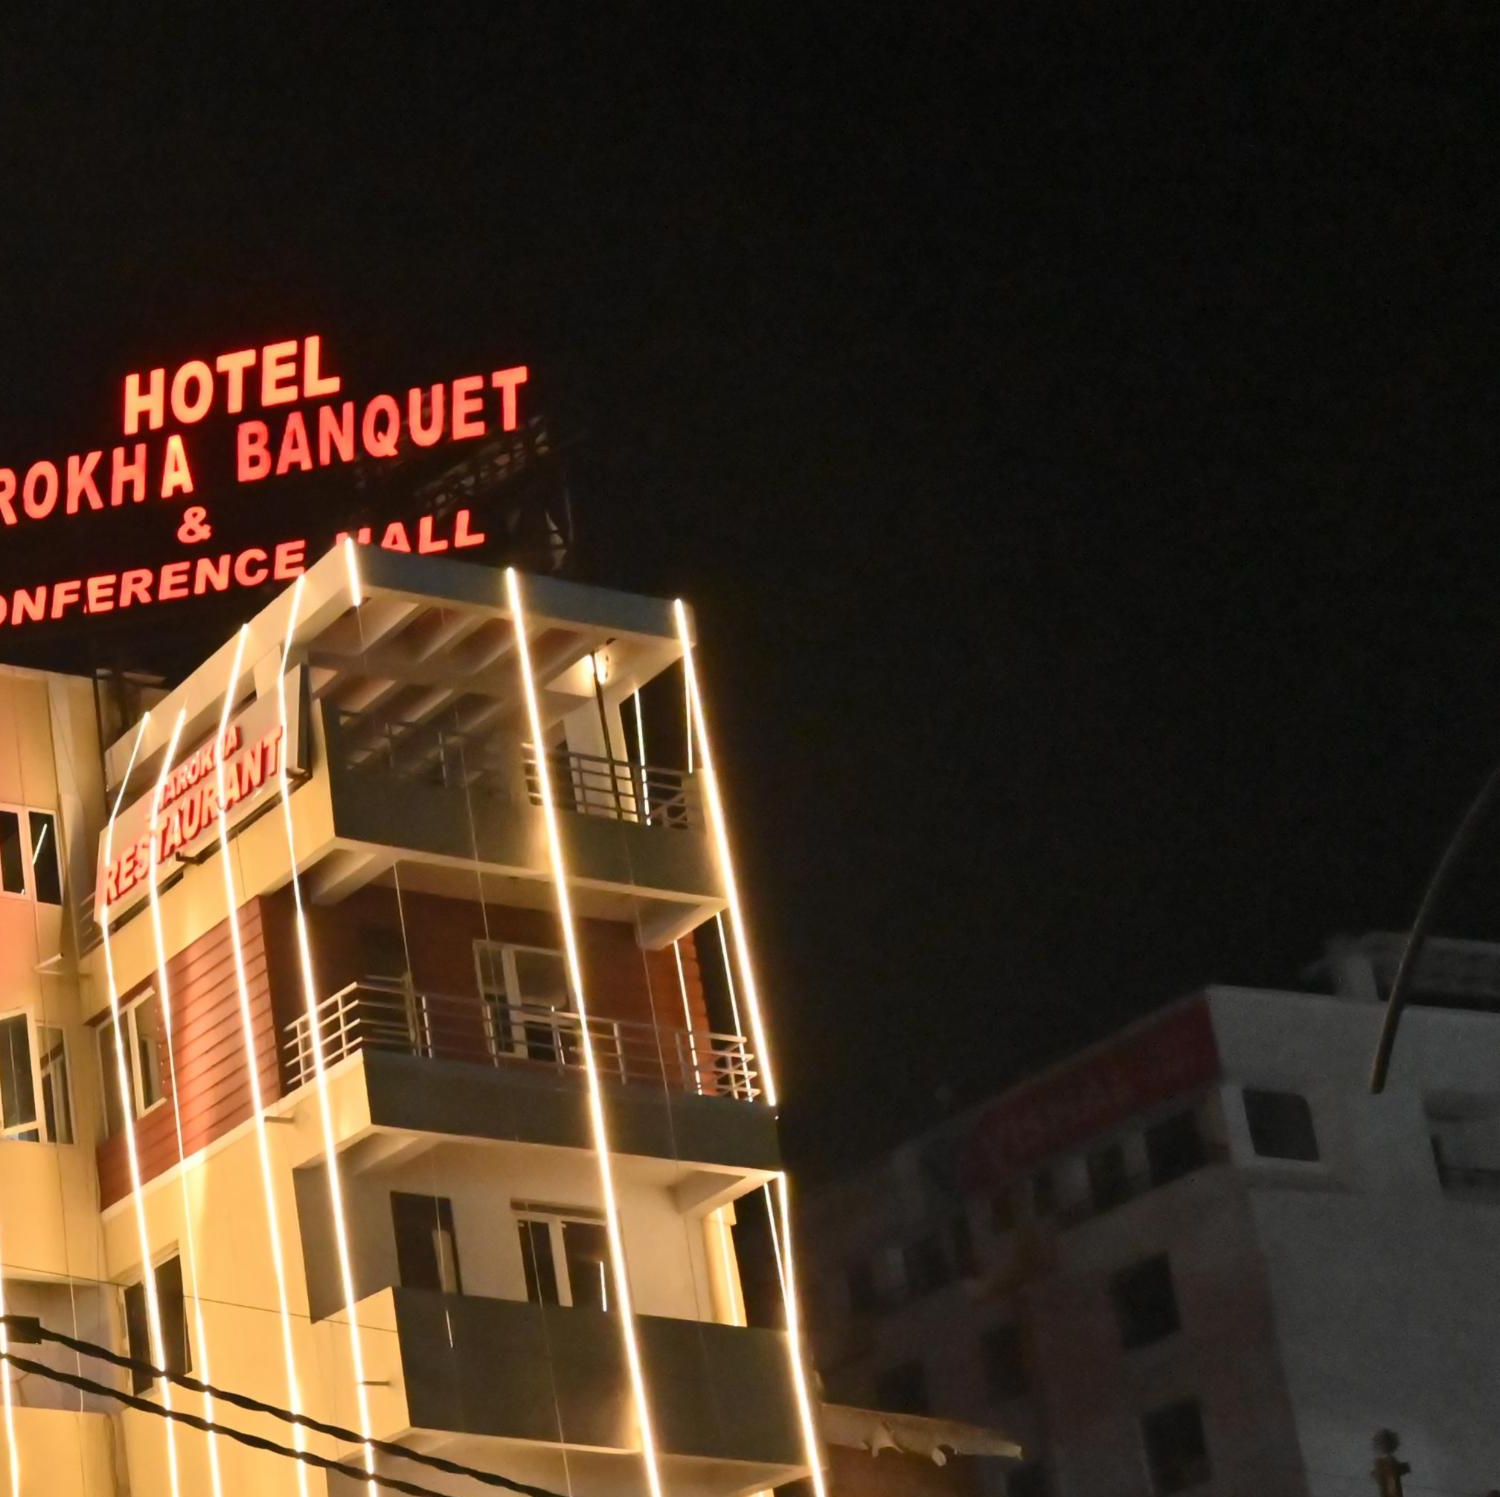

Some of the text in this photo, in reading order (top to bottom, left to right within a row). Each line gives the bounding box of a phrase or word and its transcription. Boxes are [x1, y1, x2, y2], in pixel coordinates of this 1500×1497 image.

[123, 335, 340, 435] HOTEL
[236, 365, 530, 483] BANQUET
[177, 506, 213, 544] &
[336, 509, 486, 555] ALL
